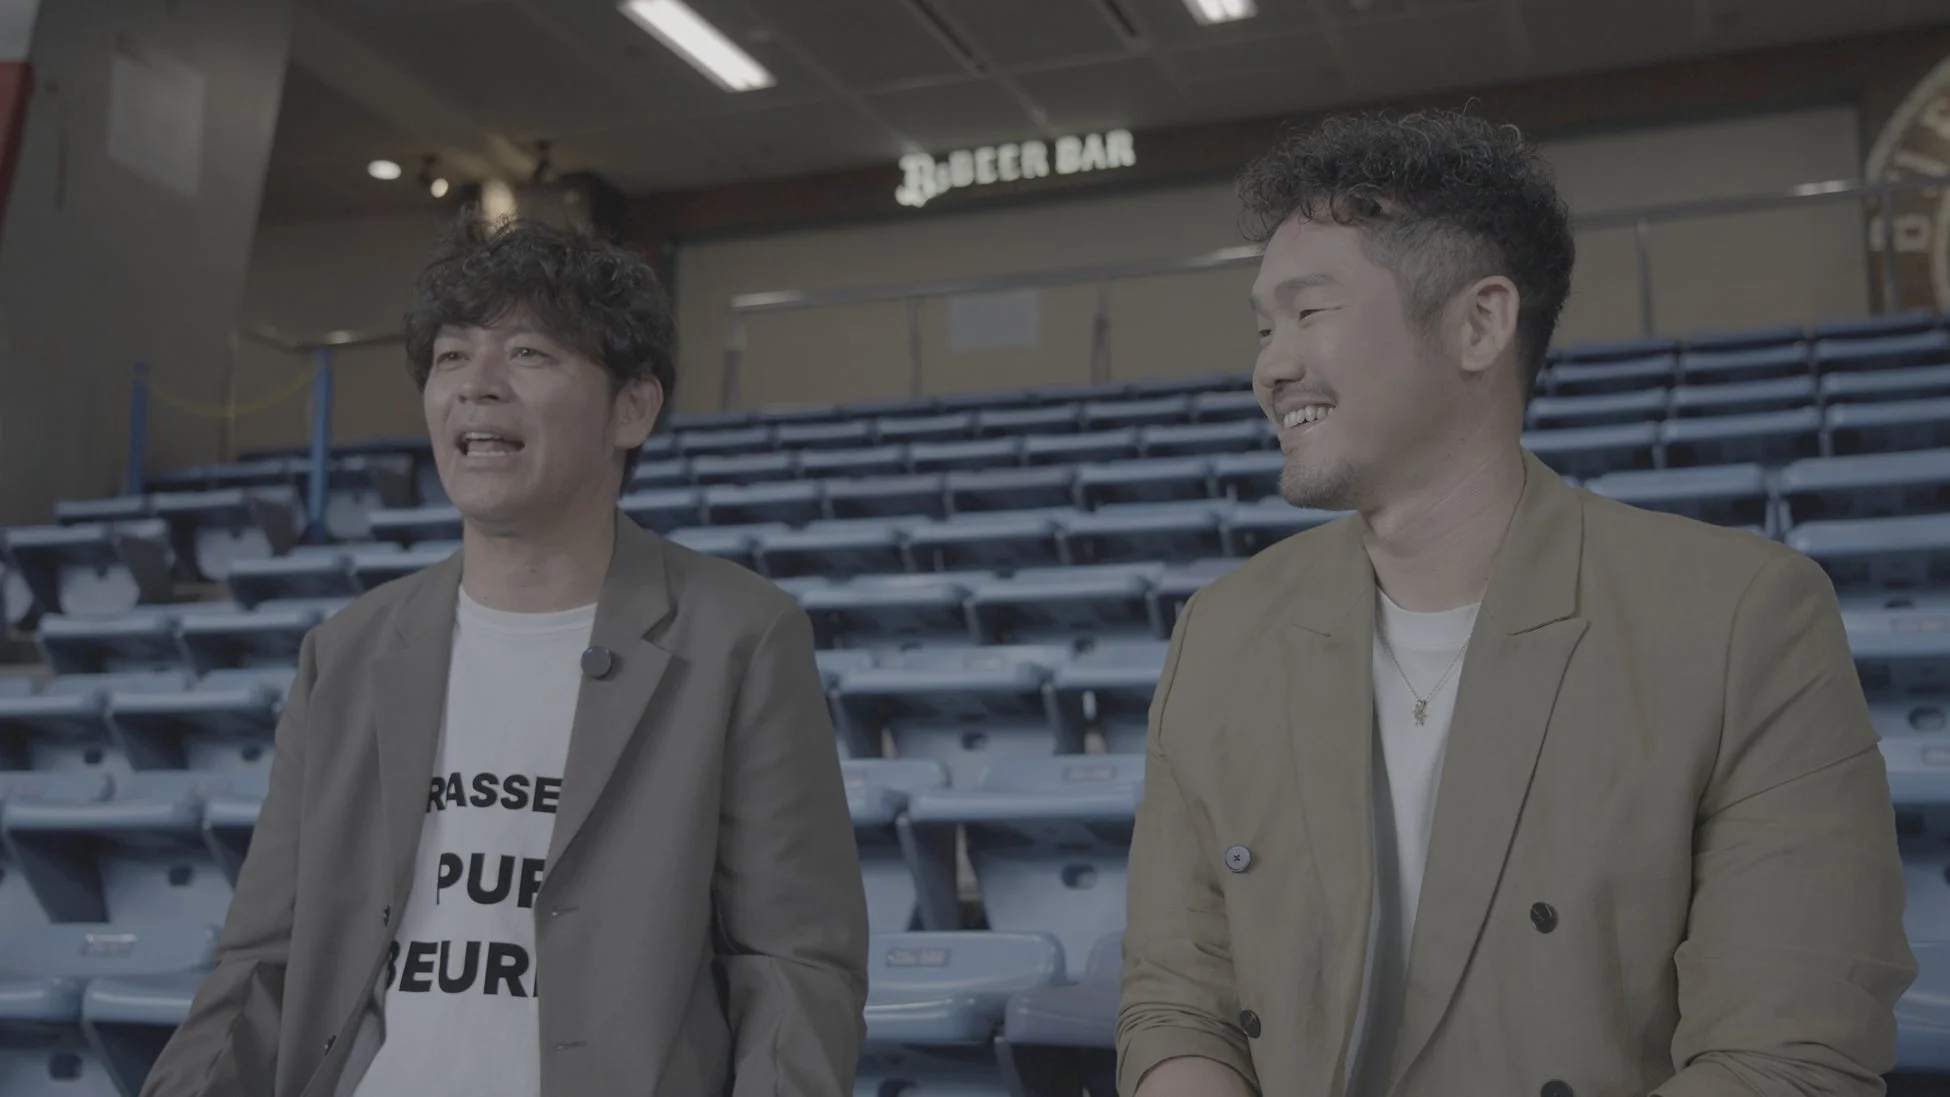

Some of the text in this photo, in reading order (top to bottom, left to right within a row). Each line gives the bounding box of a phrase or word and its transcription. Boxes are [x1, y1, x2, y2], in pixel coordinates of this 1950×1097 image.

[948, 140, 1050, 187] BEER
[1055, 128, 1136, 175] BAR
[386, 940, 538, 997] EUR
